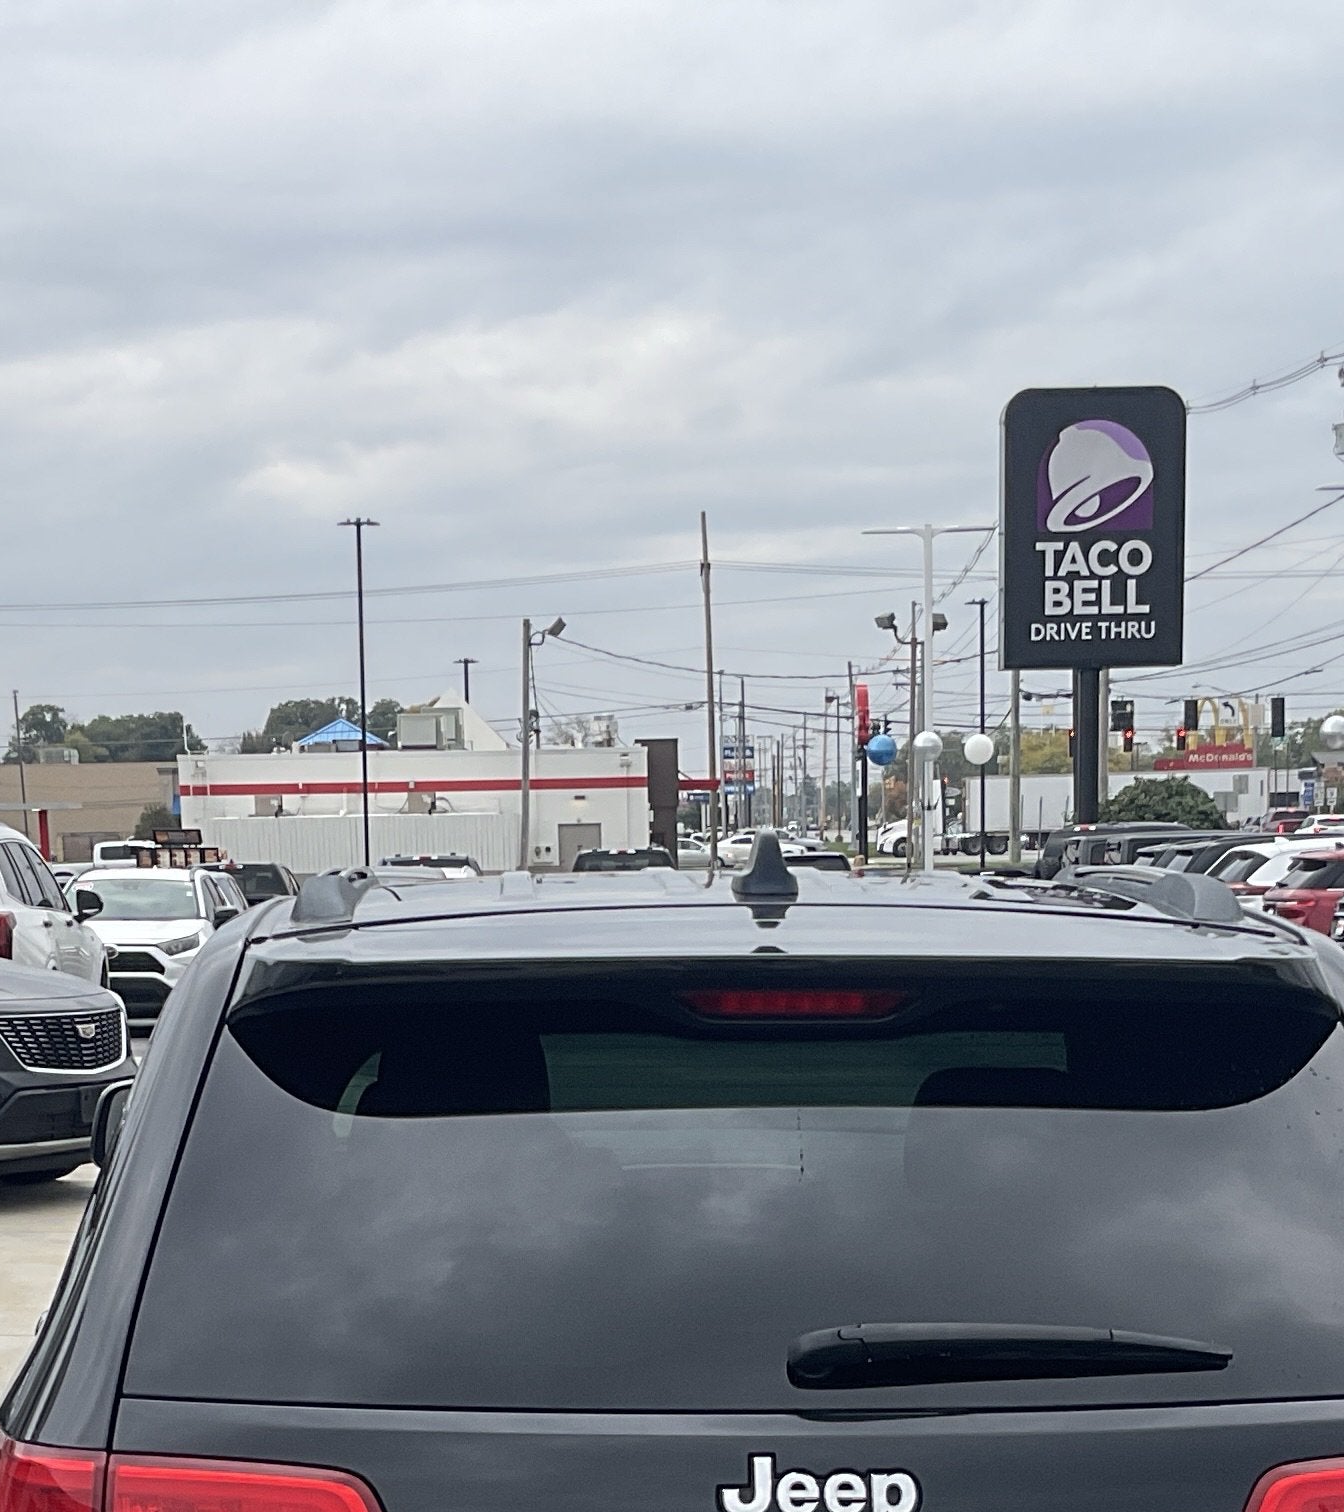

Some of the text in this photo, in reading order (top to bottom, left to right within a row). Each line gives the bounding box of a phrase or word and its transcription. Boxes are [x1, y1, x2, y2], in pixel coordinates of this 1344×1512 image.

[1035, 539, 1153, 578] TACO
[1043, 579, 1151, 617] BELL
[1030, 620, 1156, 641] DRIVE THRU
